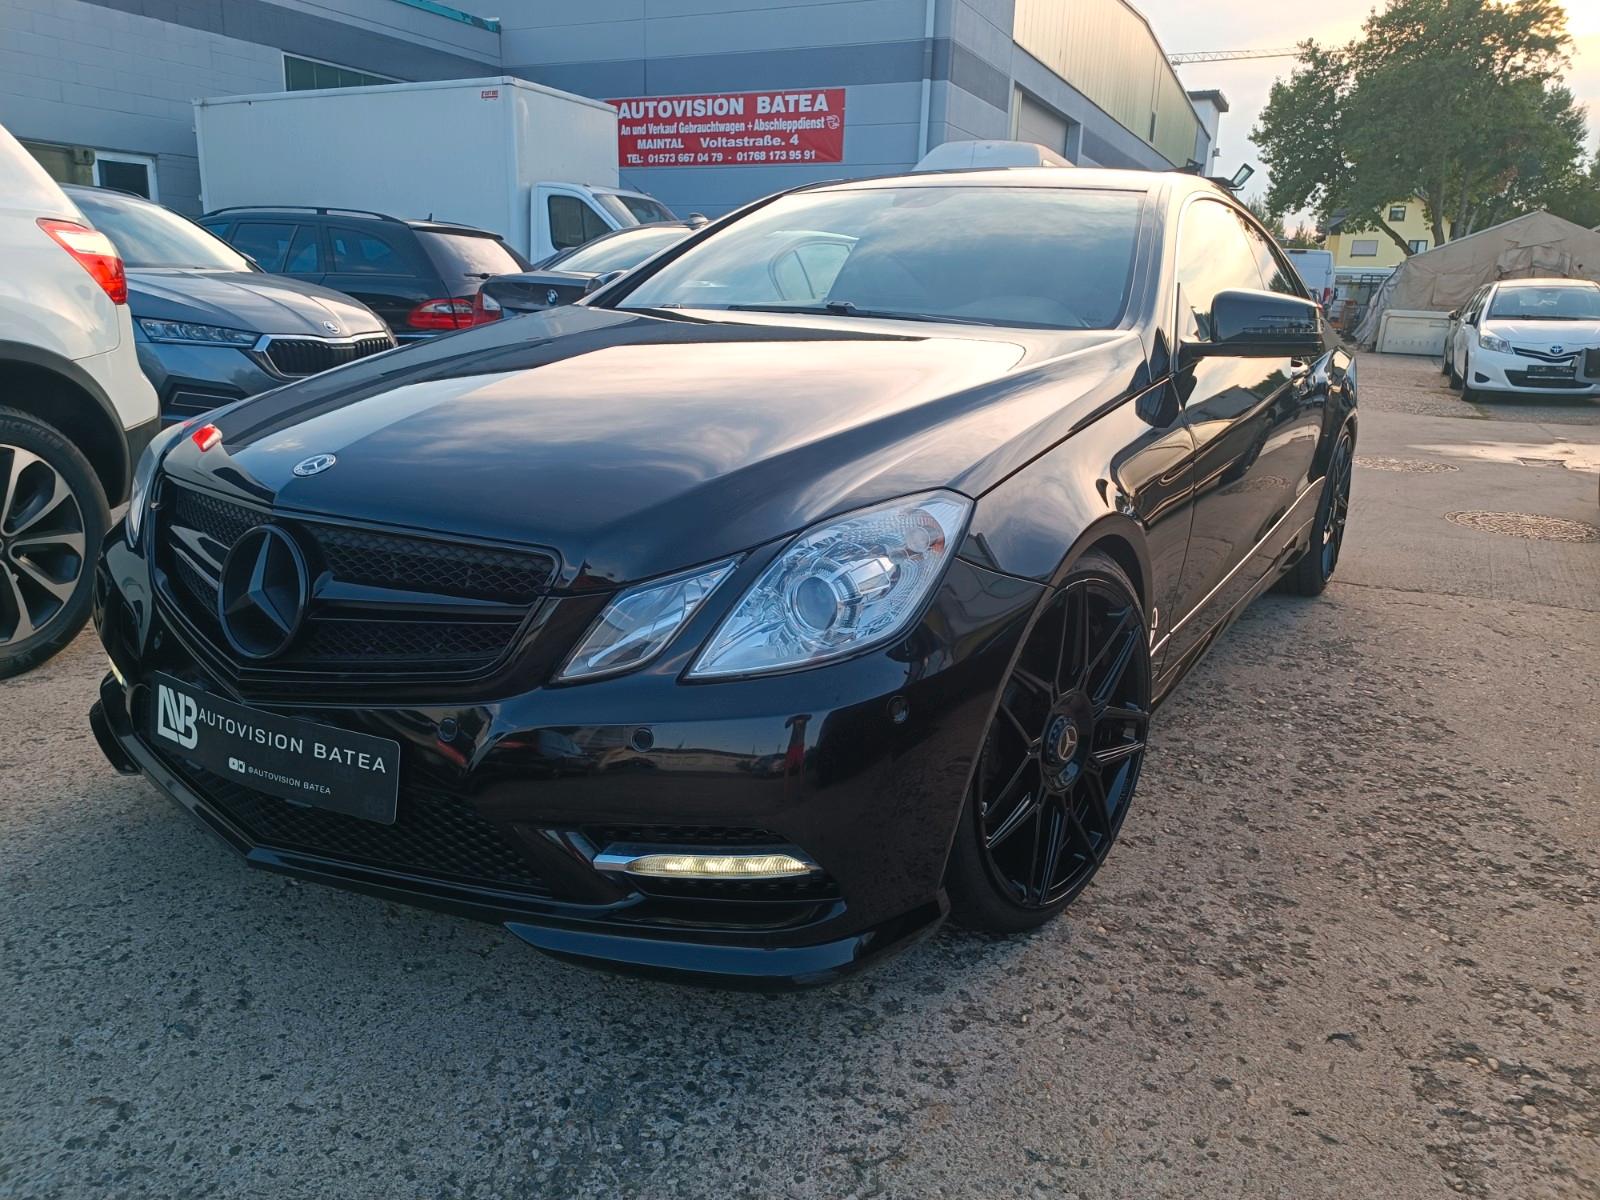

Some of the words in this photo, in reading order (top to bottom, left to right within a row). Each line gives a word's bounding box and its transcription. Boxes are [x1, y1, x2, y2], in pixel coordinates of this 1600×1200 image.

[618, 98, 743, 119] AUTOVISION
[757, 94, 829, 113] BATEA
[621, 124, 631, 135] An
[632, 123, 646, 134] und
[648, 122, 677, 134] Verkauf
[679, 121, 745, 134] Gebrauchtwagen
[754, 116, 825, 132] Abschleppdienst
[637, 138, 684, 149] MAINTAL
[700, 135, 785, 148] Voltastraße.
[790, 134, 799, 145] 4
[627, 154, 644, 163] TEL:
[648, 154, 675, 163] 01573
[678, 153, 694, 162] 667
[697, 153, 709, 162] 04
[711, 152, 723, 162] 79
[736, 151, 766, 161] 01768
[769, 151, 787, 160] 173
[790, 151, 801, 160] 95
[804, 150, 816, 159] 91
[198, 707, 303, 754] AUTOVISION
[313, 742, 386, 774] BATEA
[303, 781, 331, 795] BATEA
